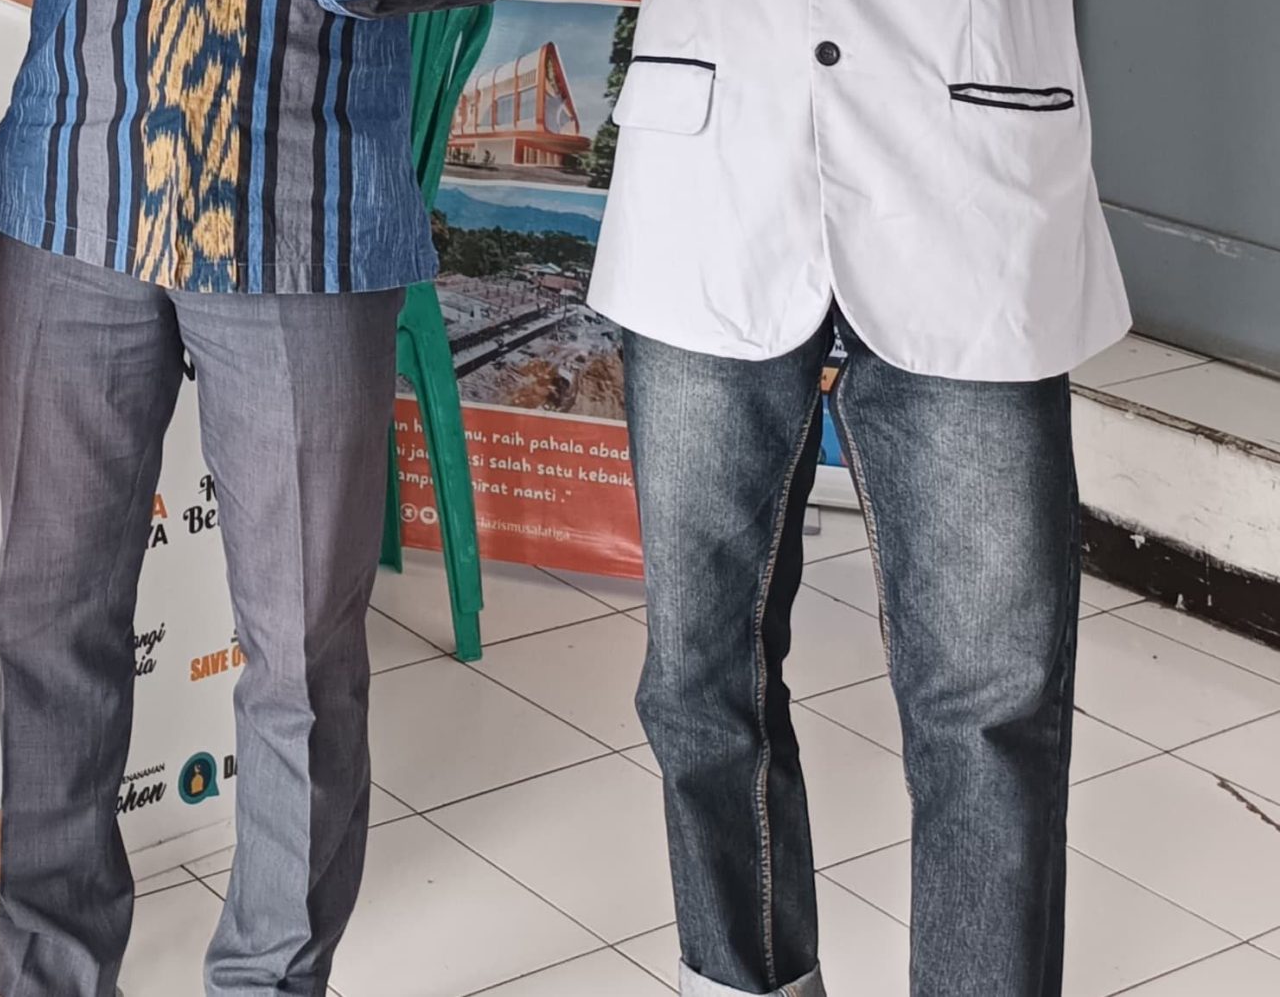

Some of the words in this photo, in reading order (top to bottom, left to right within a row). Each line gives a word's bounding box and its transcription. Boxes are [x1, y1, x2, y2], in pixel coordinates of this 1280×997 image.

[492, 432, 525, 447] raih
[530, 437, 584, 457] pahala
[589, 442, 630, 461] abad
[489, 456, 531, 474] salah
[537, 464, 573, 479] satu
[578, 465, 634, 488] kebaik
[513, 485, 556, 503] nanti
[182, 505, 219, 534] Be
[477, 516, 571, 542] lazismusalatiga
[190, 649, 229, 682] SAVE
[122, 762, 166, 784] ENANAMAN
